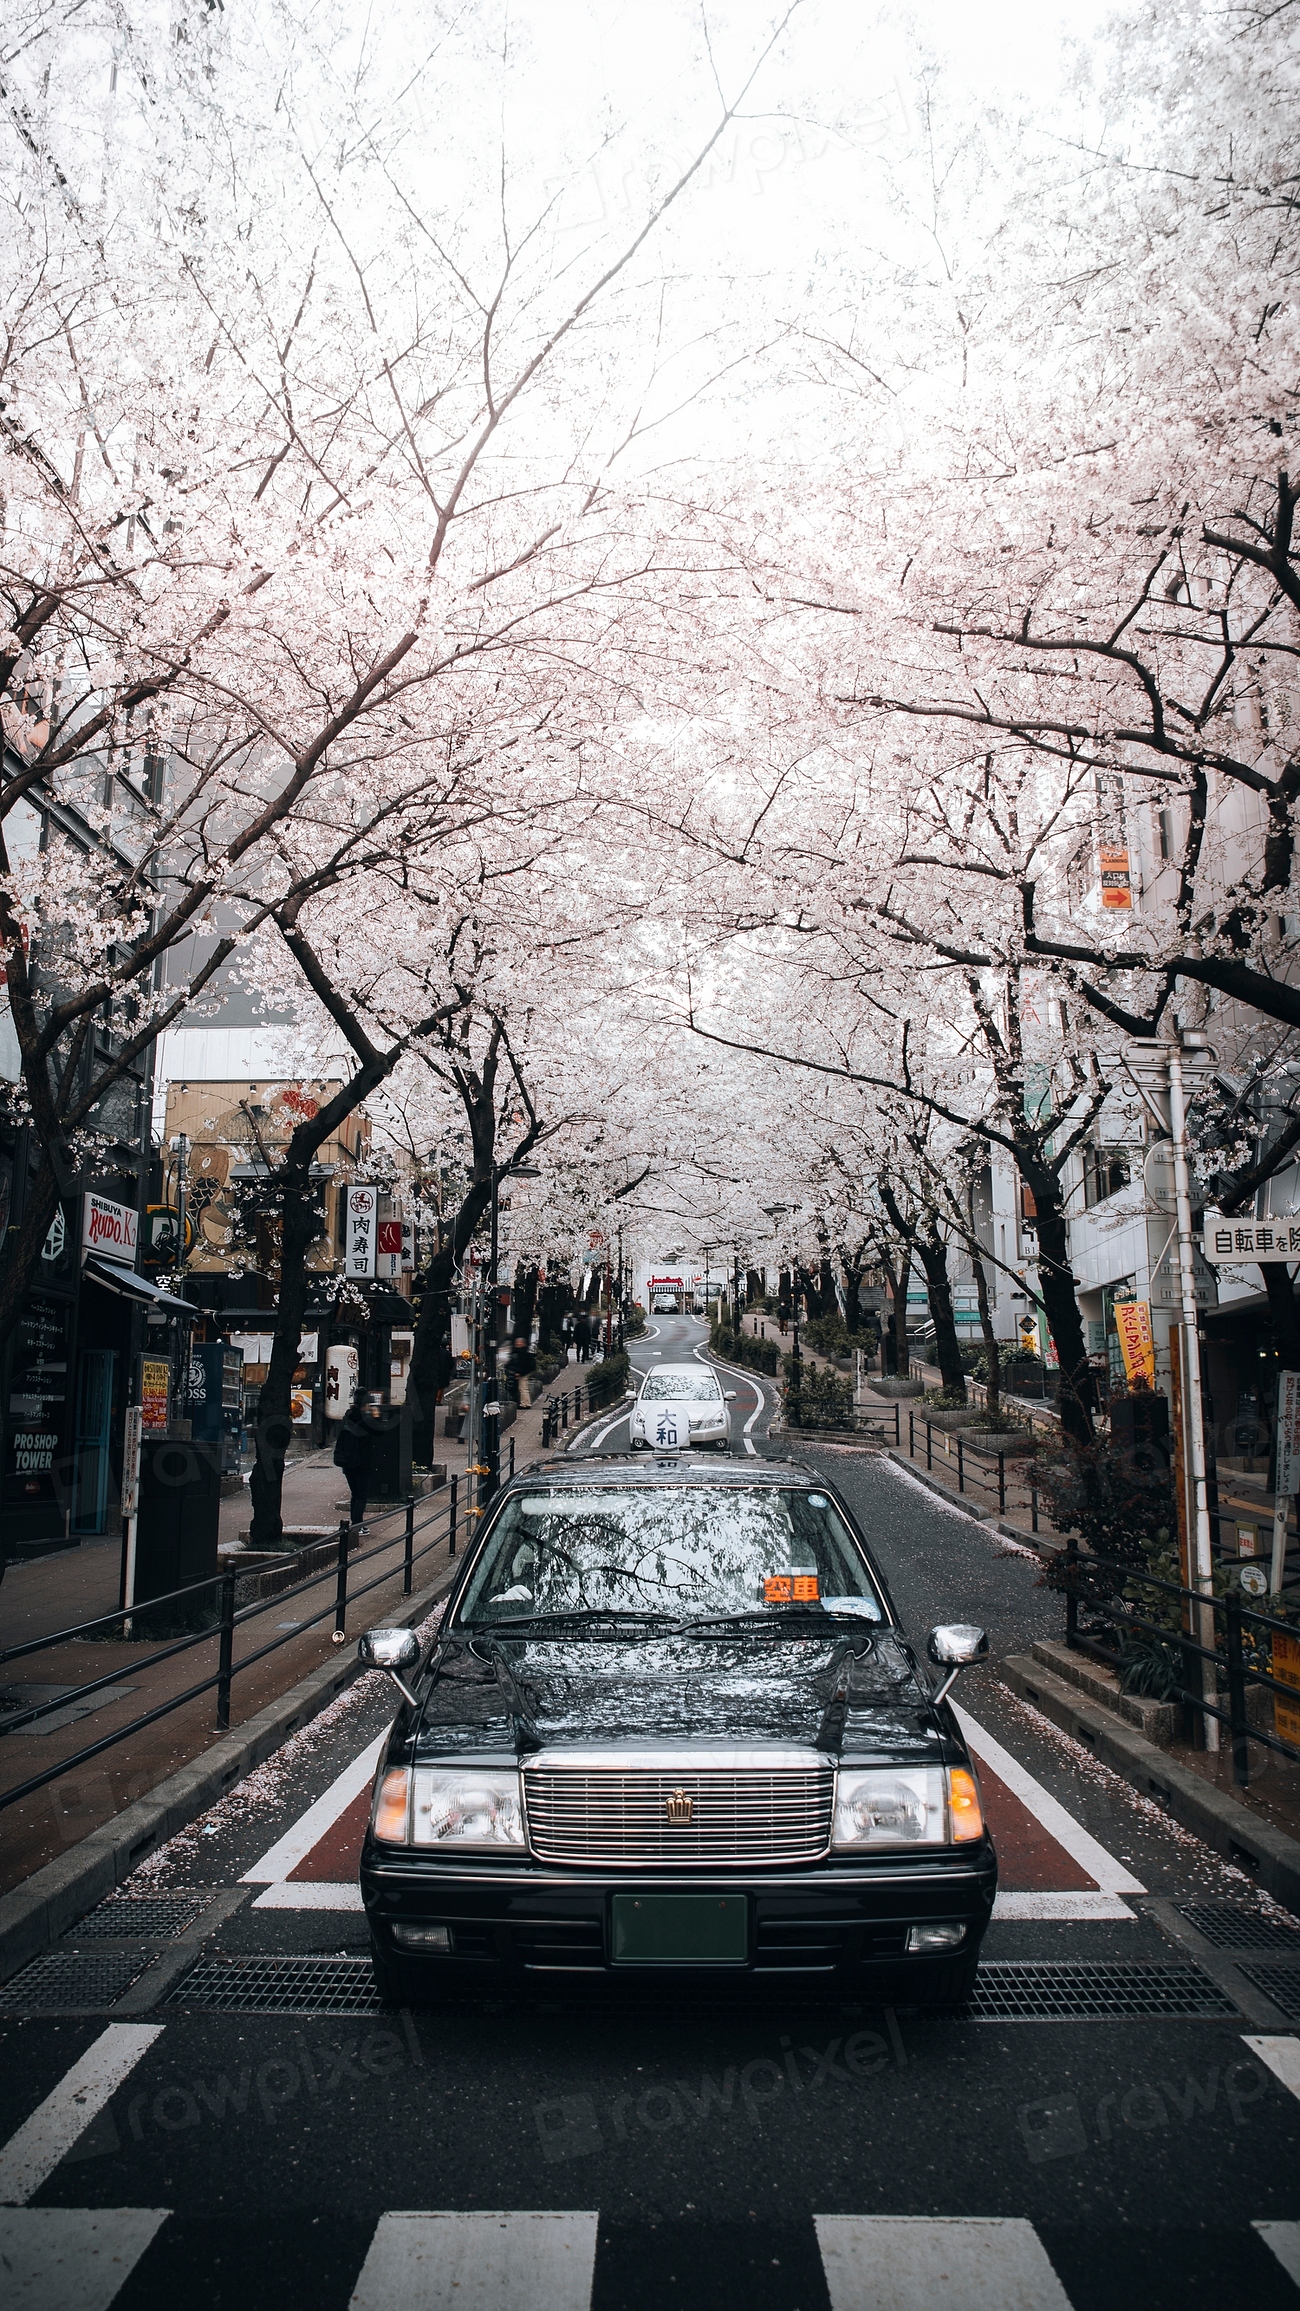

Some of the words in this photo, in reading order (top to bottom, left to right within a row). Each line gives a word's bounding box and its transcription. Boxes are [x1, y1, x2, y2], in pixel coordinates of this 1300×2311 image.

[91, 1198, 122, 1217] SHIBUYA
[351, 1216, 371, 1274] 肉寿司
[1025, 1246, 1036, 1255] B1
[656, 1409, 677, 1445] 大和
[14, 1433, 34, 1449] PRO
[33, 1433, 58, 1449] SHOP
[16, 1451, 53, 1469] TOWER
